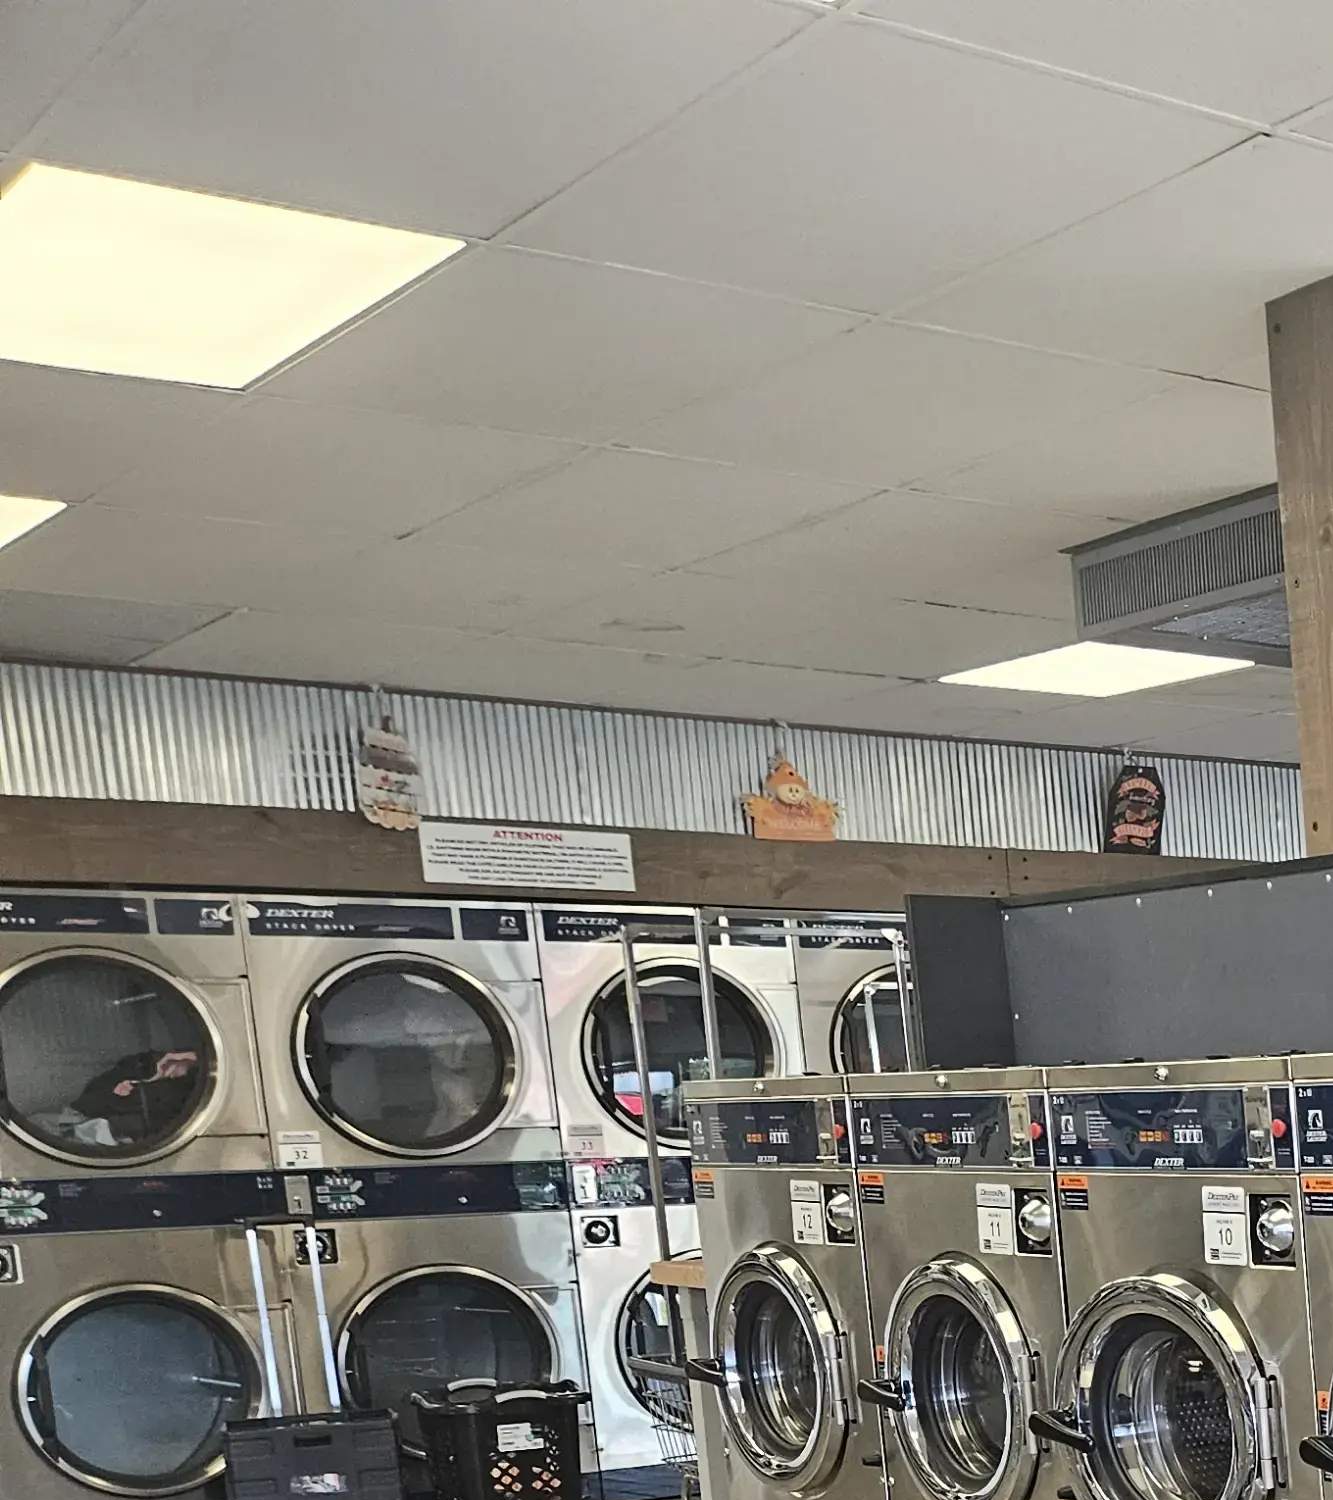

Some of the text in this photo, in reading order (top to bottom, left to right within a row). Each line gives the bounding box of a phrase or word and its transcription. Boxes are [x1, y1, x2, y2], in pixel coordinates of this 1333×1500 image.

[493, 830, 563, 842] ATTENTION
[266, 908, 334, 918] DEXTER
[557, 917, 618, 926] DEXTER
[581, 1141, 593, 1150] 33
[295, 1150, 308, 1160] 32
[936, 1156, 961, 1165] DEXTER
[1154, 1157, 1184, 1167] DEXTER
[803, 1214, 812, 1229] 12
[990, 1221, 1001, 1237] 11
[1219, 1228, 1233, 1245] 10
